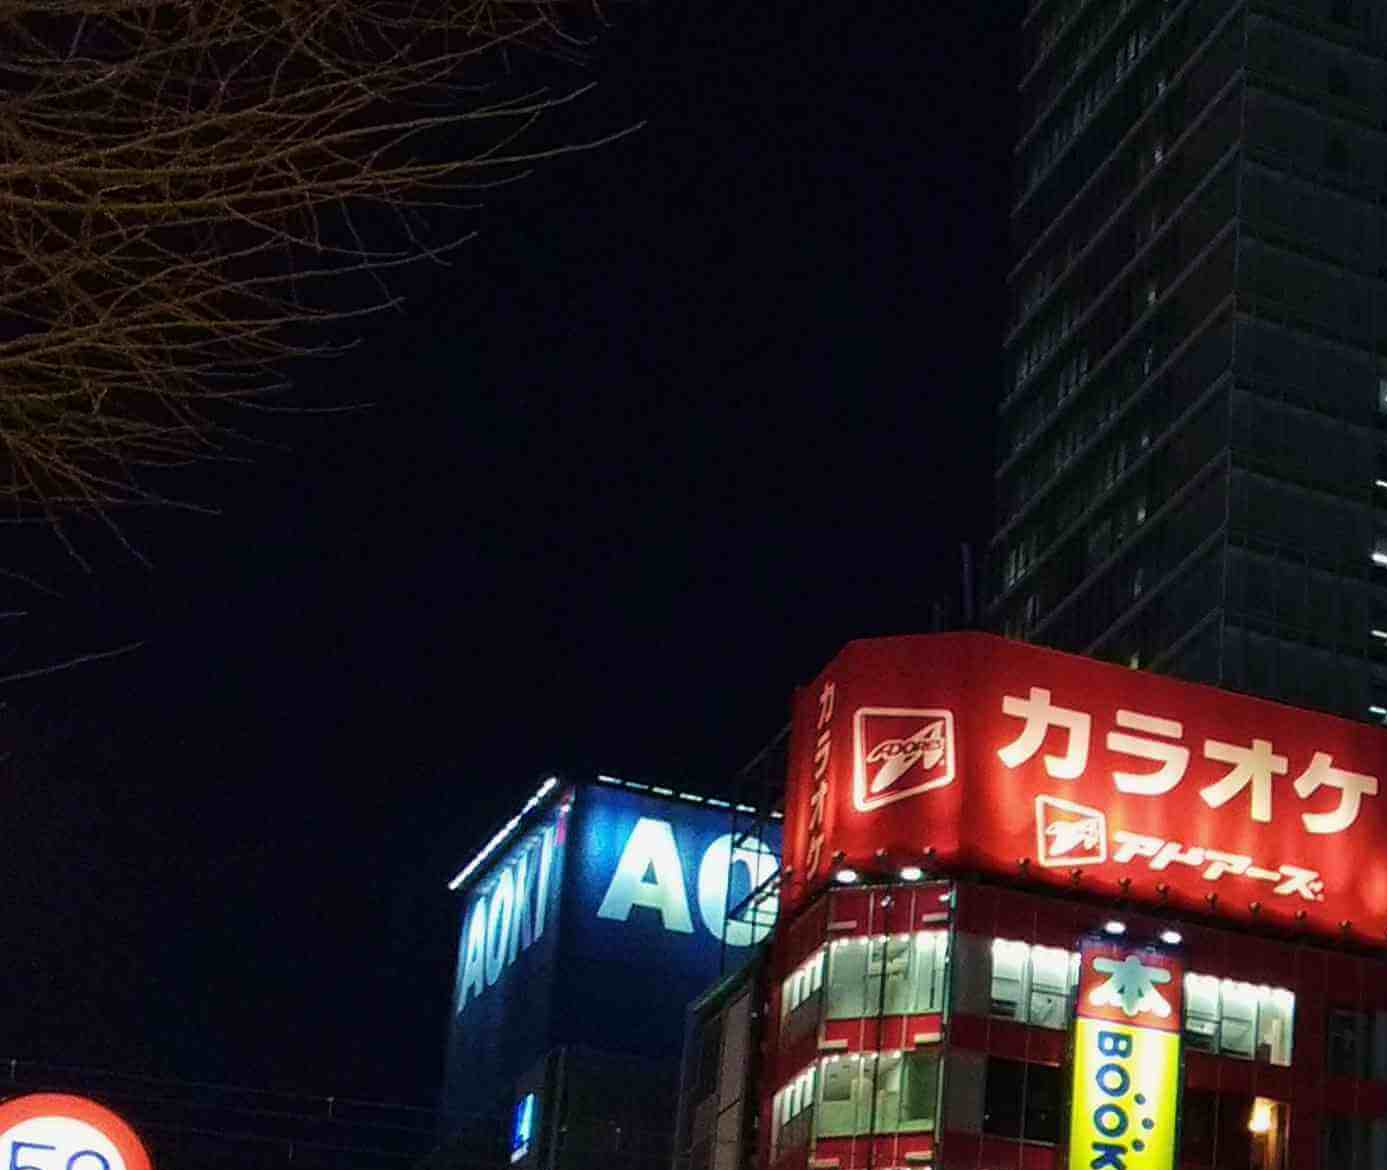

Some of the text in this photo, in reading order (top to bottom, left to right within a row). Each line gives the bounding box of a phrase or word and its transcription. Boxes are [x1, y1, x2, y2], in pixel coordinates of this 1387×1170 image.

[994, 686, 1379, 834] カラオケ
[457, 824, 556, 1015] AOKI
[1113, 831, 1326, 903] アドアーズ
